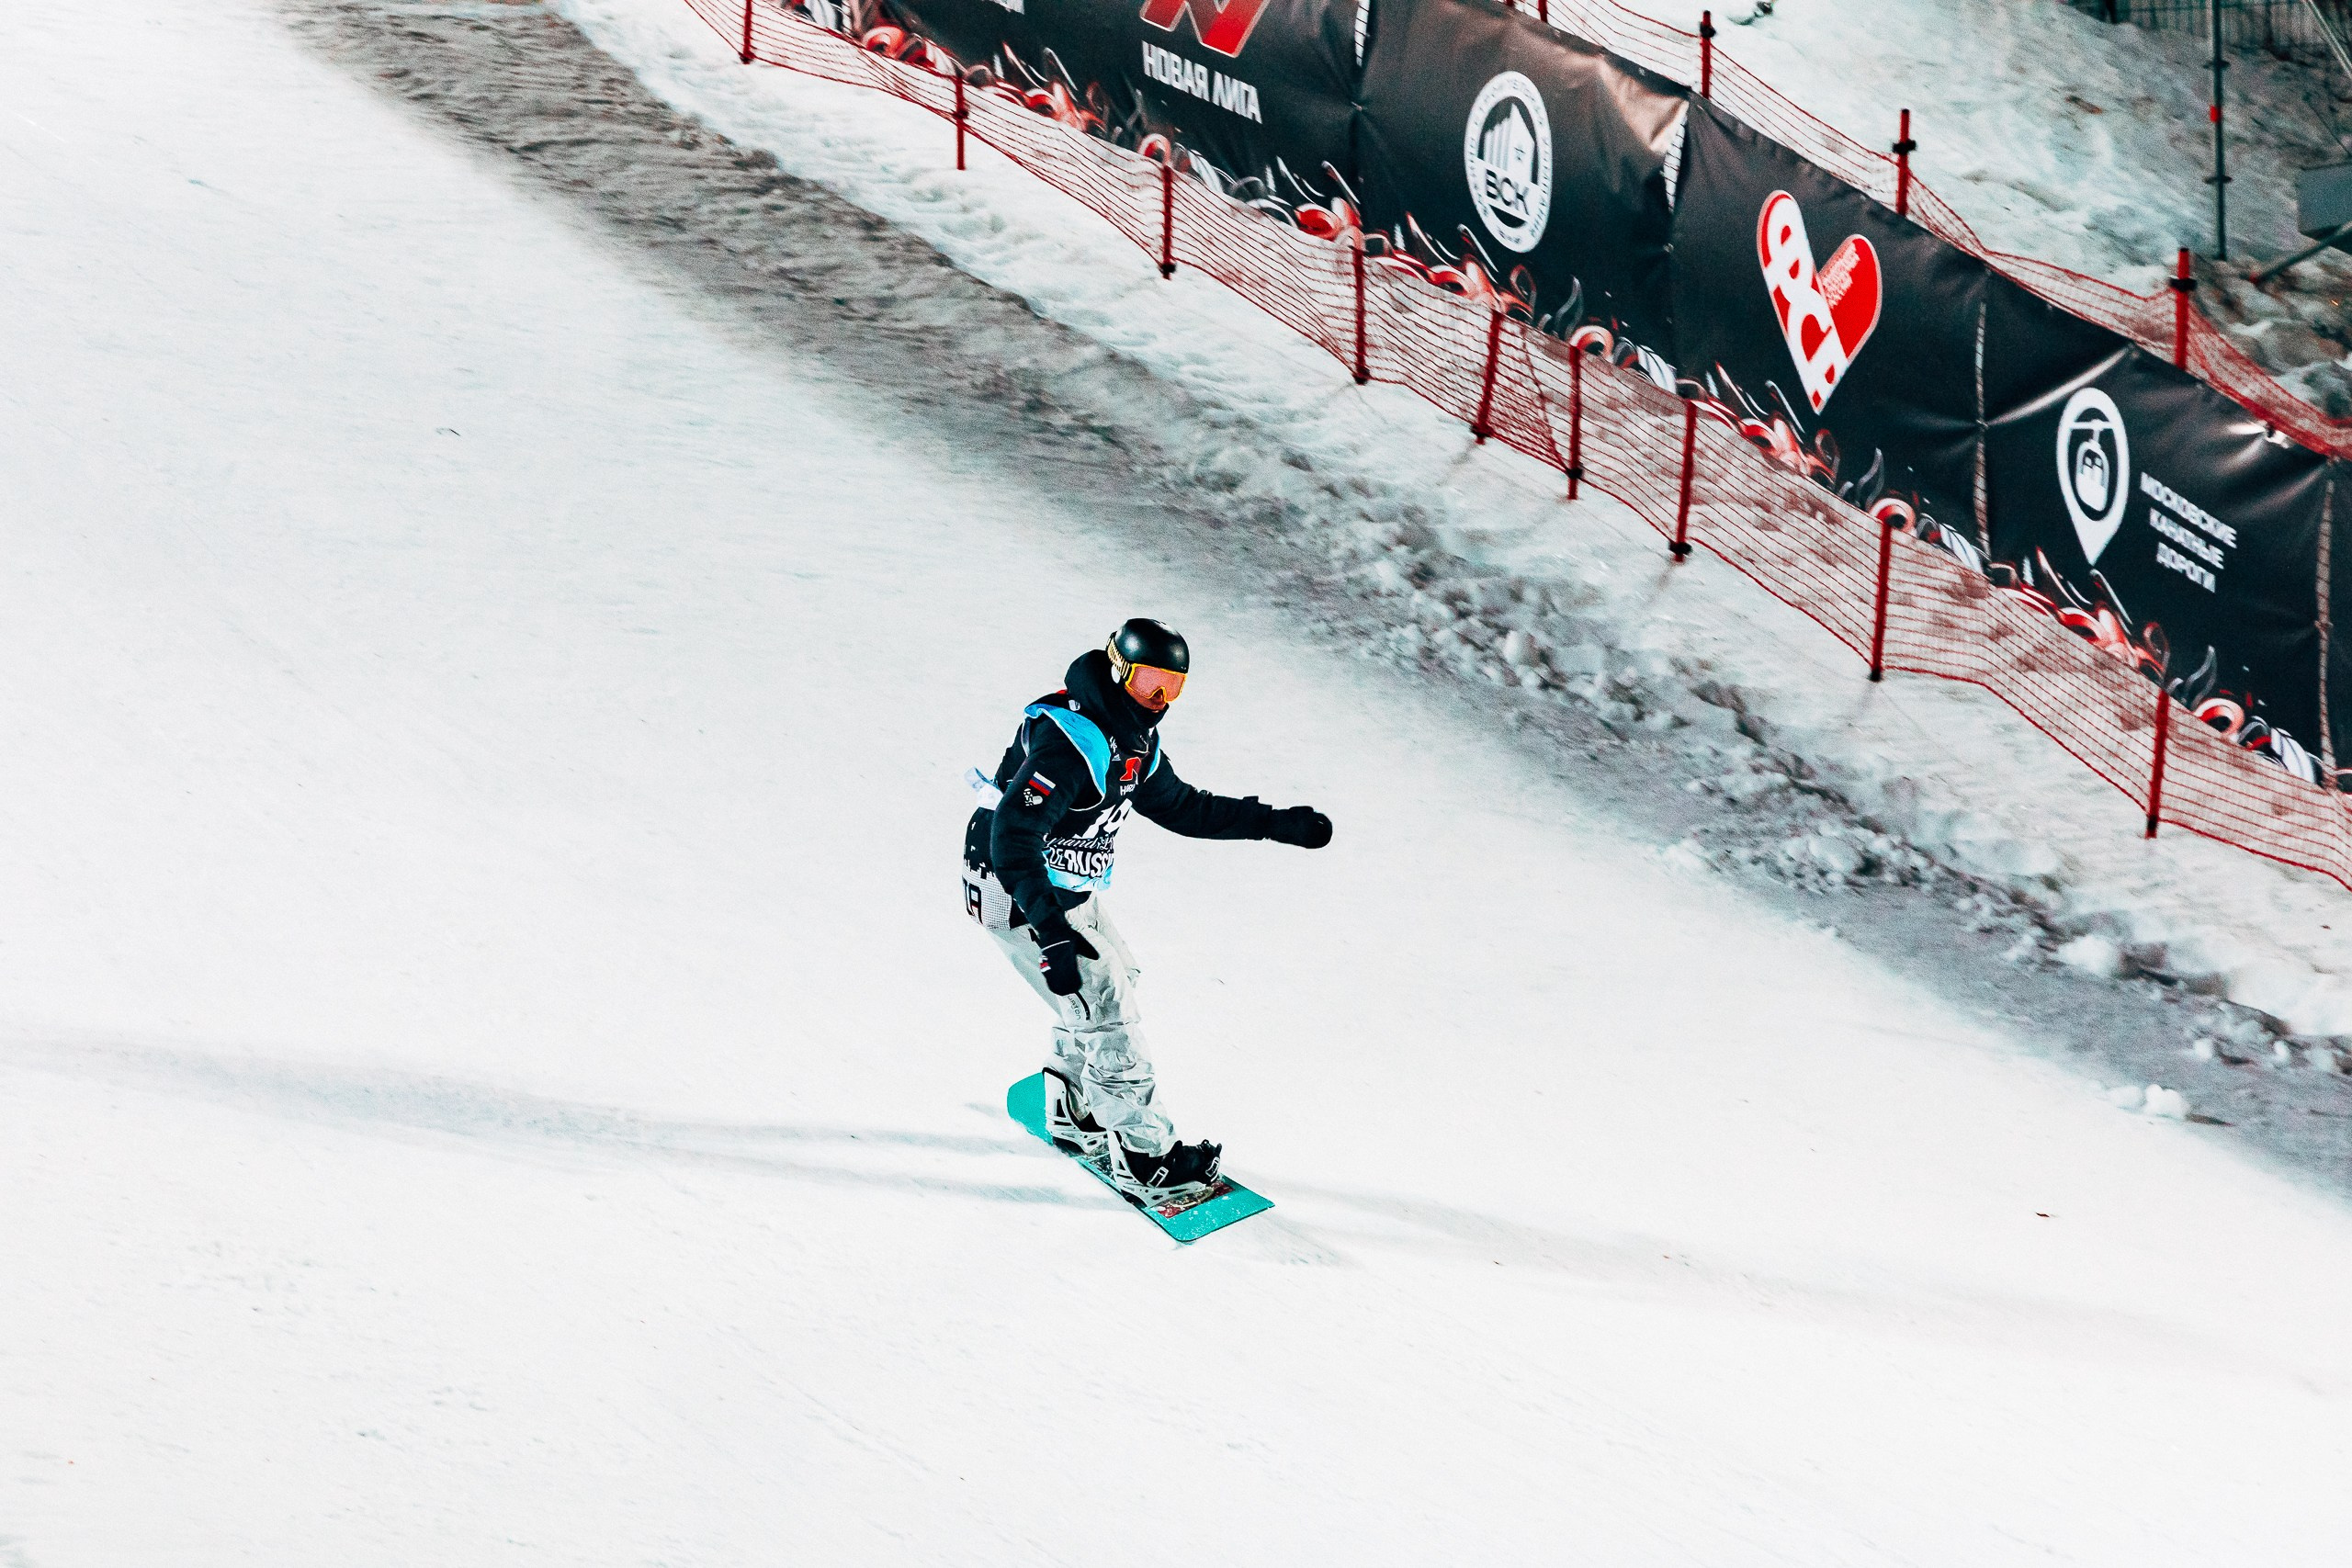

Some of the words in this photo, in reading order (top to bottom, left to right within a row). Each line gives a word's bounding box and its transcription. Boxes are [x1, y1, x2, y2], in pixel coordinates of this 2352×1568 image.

[1142, 40, 1210, 102] НОВАЯ
[1212, 71, 1262, 124] ЛИГА
[2140, 471, 2237, 548] МОСКОВСКИЕ
[2150, 507, 2224, 570] КАНАТНЫЕ
[2156, 542, 2216, 592] ДОРОГИ
